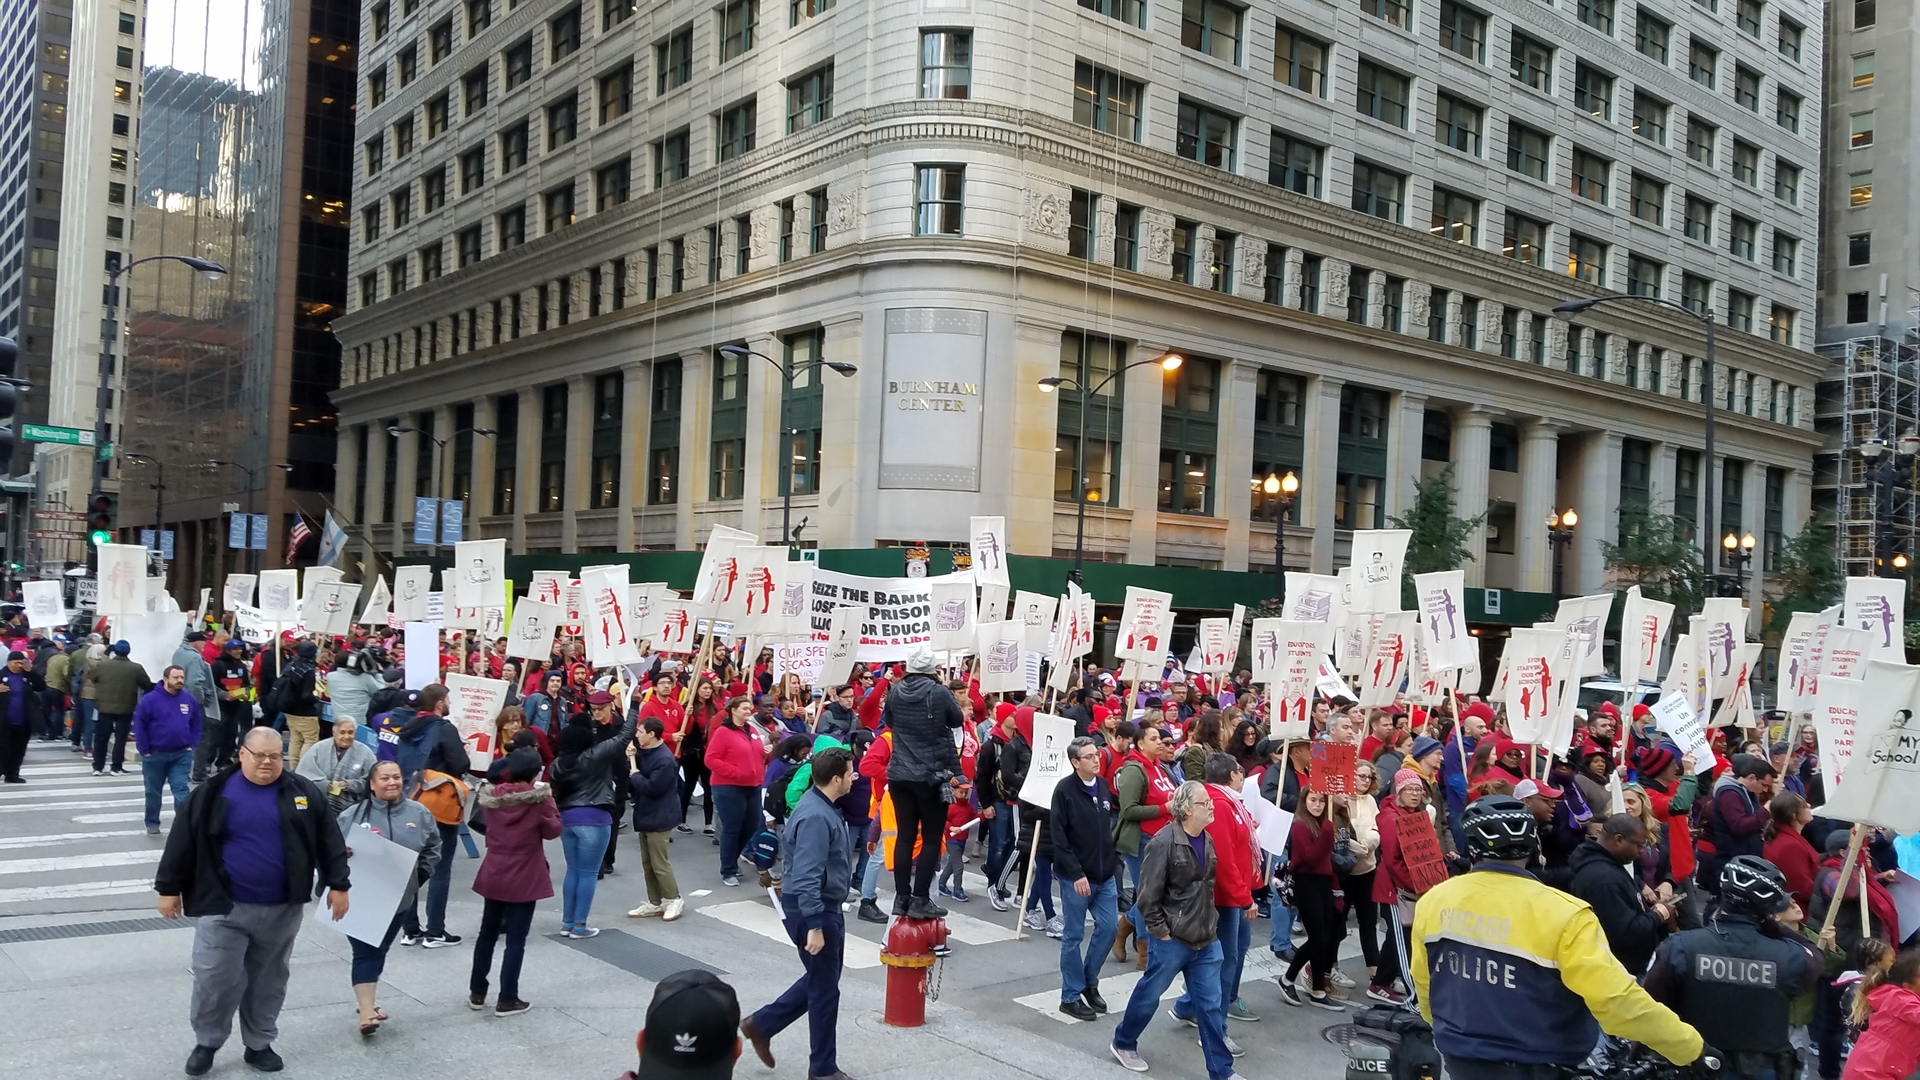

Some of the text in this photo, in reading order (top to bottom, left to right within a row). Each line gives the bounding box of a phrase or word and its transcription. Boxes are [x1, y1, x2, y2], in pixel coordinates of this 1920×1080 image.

[888, 381, 978, 396] BURNHAM
[898, 398, 966, 412] CENTER
[1368, 574, 1389, 583] School
[812, 580, 931, 605] SEIZE THE BANK
[882, 622, 930, 636] EDUCA
[903, 636, 930, 644] Libe
[1678, 712, 1690, 720] Un
[1898, 736, 1920, 749] MY
[1049, 753, 1058, 761] MY
[1872, 749, 1919, 764] School
[1039, 762, 1059, 772] School
[1439, 908, 1512, 942] CHICAGO
[1434, 950, 1518, 990] POLICE
[1699, 956, 1773, 985] POLICE
[1348, 1058, 1388, 1072] OLICE
